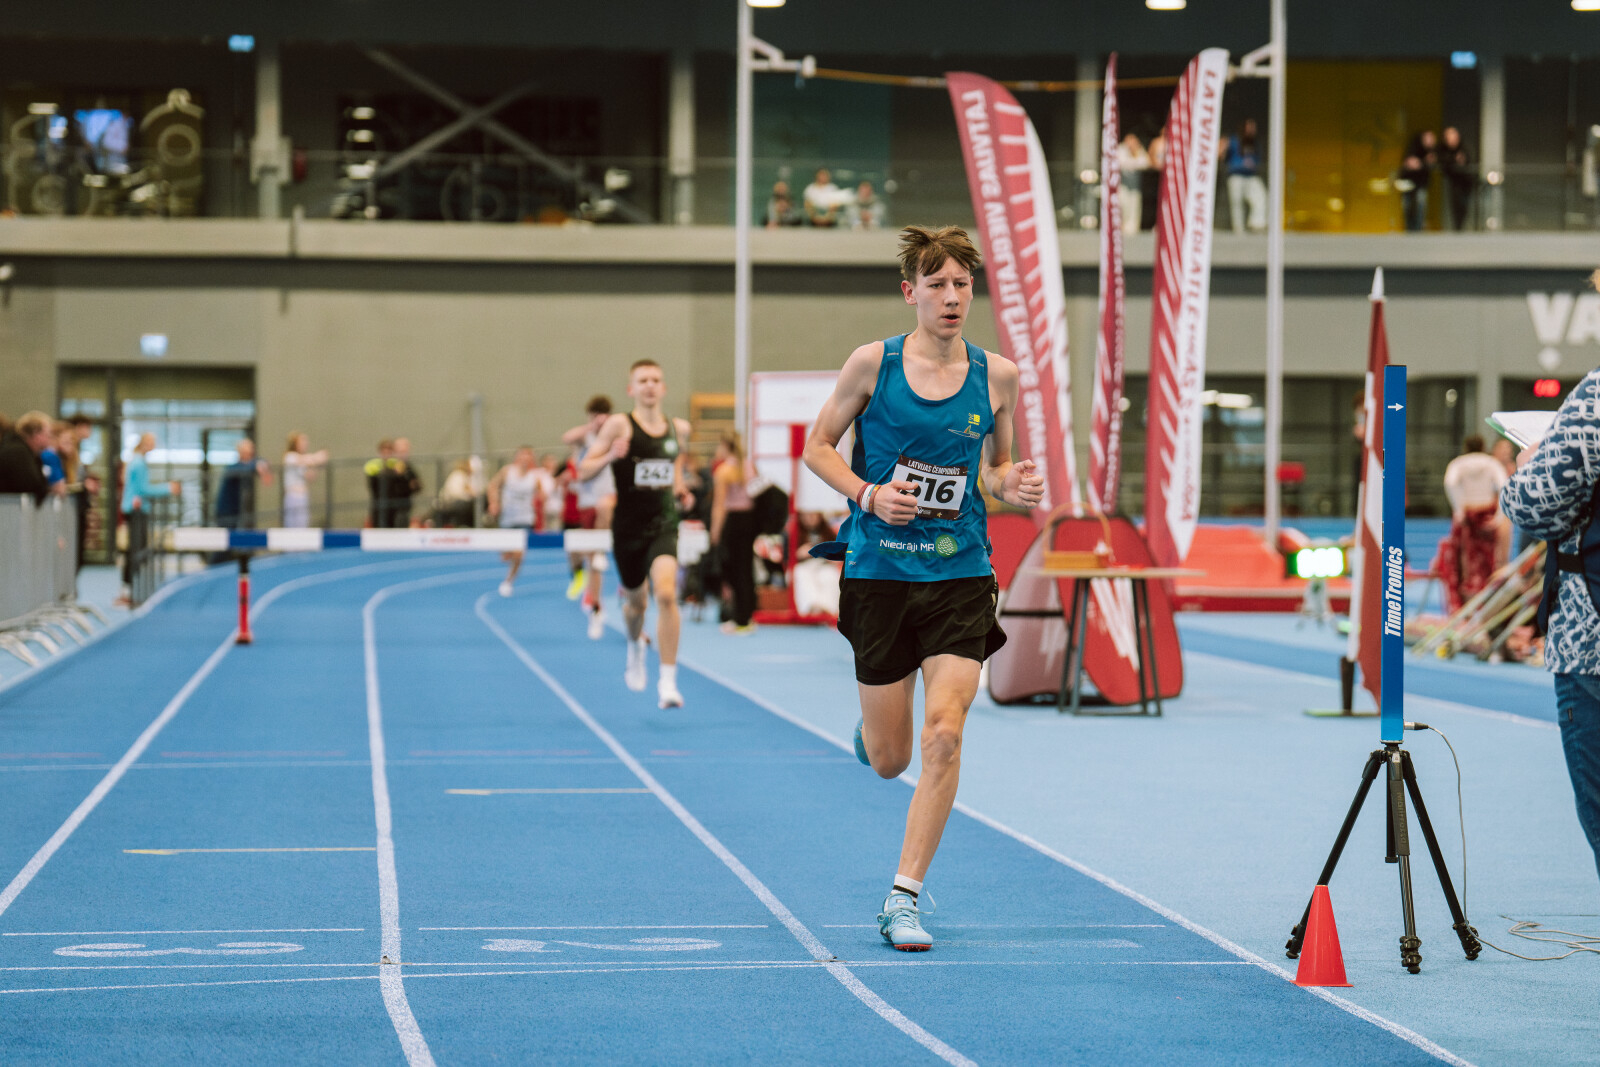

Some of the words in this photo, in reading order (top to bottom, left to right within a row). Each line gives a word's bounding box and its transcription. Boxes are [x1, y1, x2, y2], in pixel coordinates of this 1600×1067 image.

[1196, 68, 1218, 182] LATVIJAS
[907, 460, 932, 473] LATVIJAS
[900, 472, 957, 504] 516
[879, 539, 918, 552] Niedrāji
[920, 542, 935, 551] MR
[1385, 546, 1402, 637] TimeTronics
[53, 942, 304, 958] 3
[480, 937, 722, 953] 2
